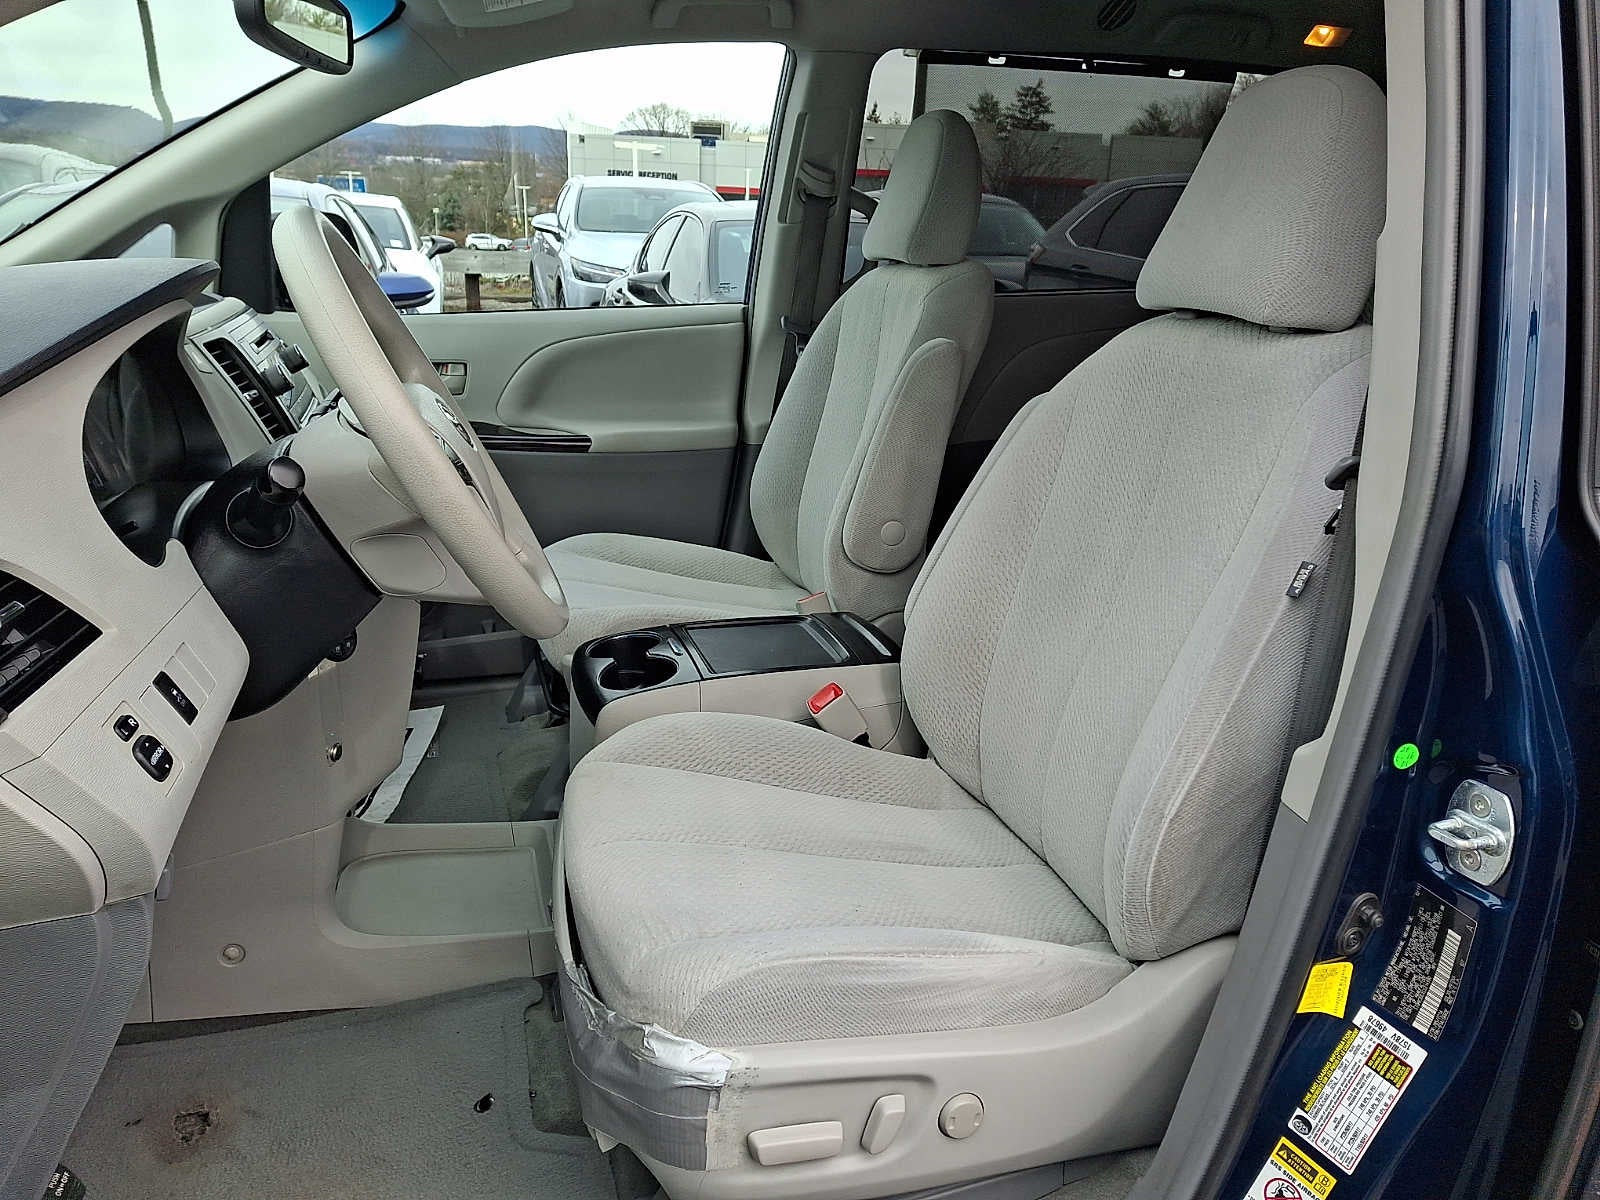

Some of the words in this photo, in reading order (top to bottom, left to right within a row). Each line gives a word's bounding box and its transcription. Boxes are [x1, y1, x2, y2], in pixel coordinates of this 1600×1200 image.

[607, 169, 634, 177] SERVIC
[638, 171, 678, 180] RECEPTION
[1287, 1158, 1314, 1182] ATTENTION
[1290, 1153, 1312, 1173] CAUTION
[48, 1172, 61, 1189] PUSH
